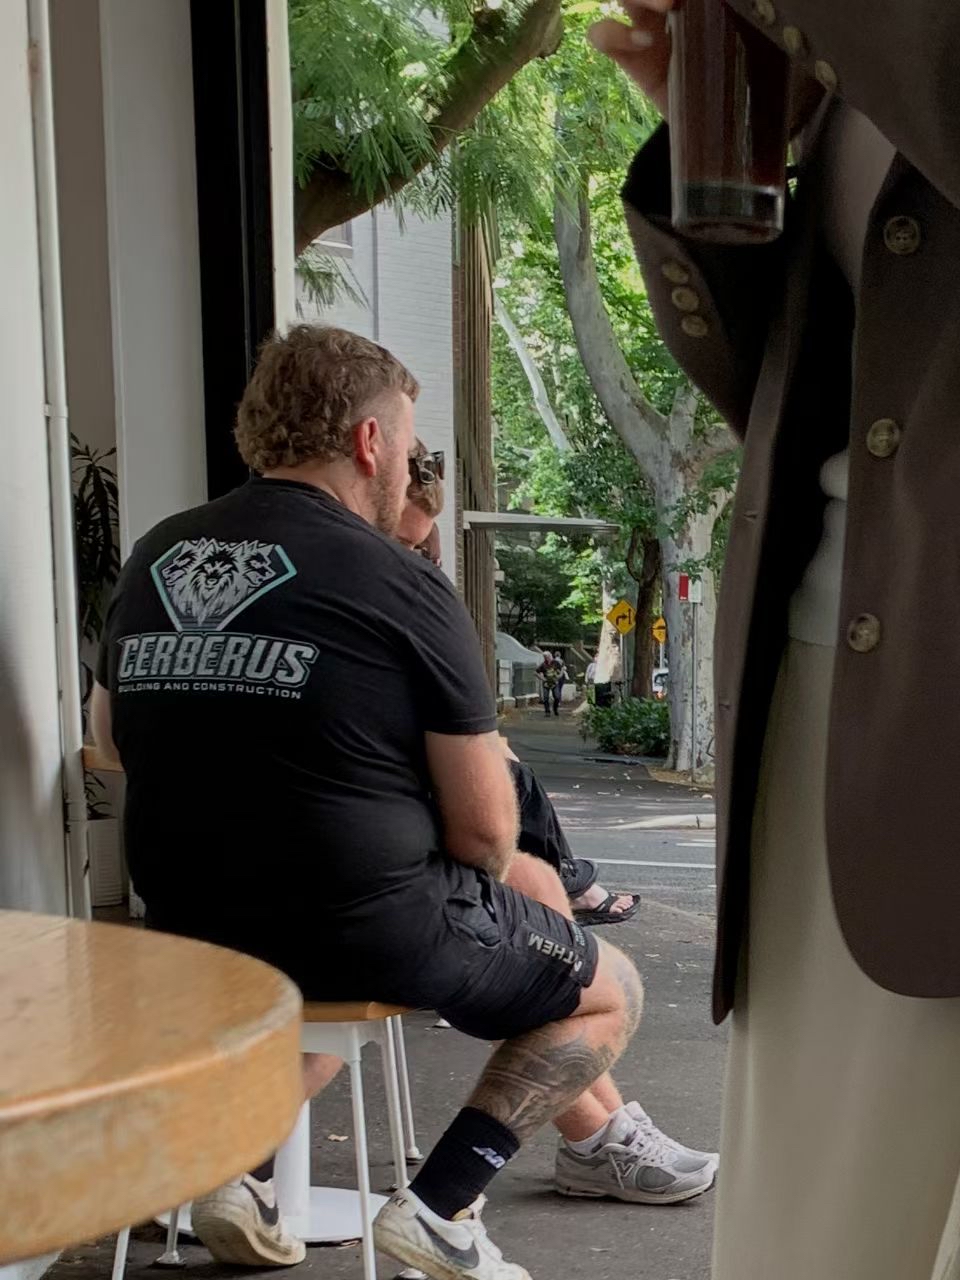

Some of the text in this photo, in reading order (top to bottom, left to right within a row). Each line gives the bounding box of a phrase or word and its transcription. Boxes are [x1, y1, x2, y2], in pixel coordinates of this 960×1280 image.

[117, 632, 319, 687] CERBERUS
[164, 682, 189, 691] AND
[192, 682, 302, 699] CONSTRUCTION
